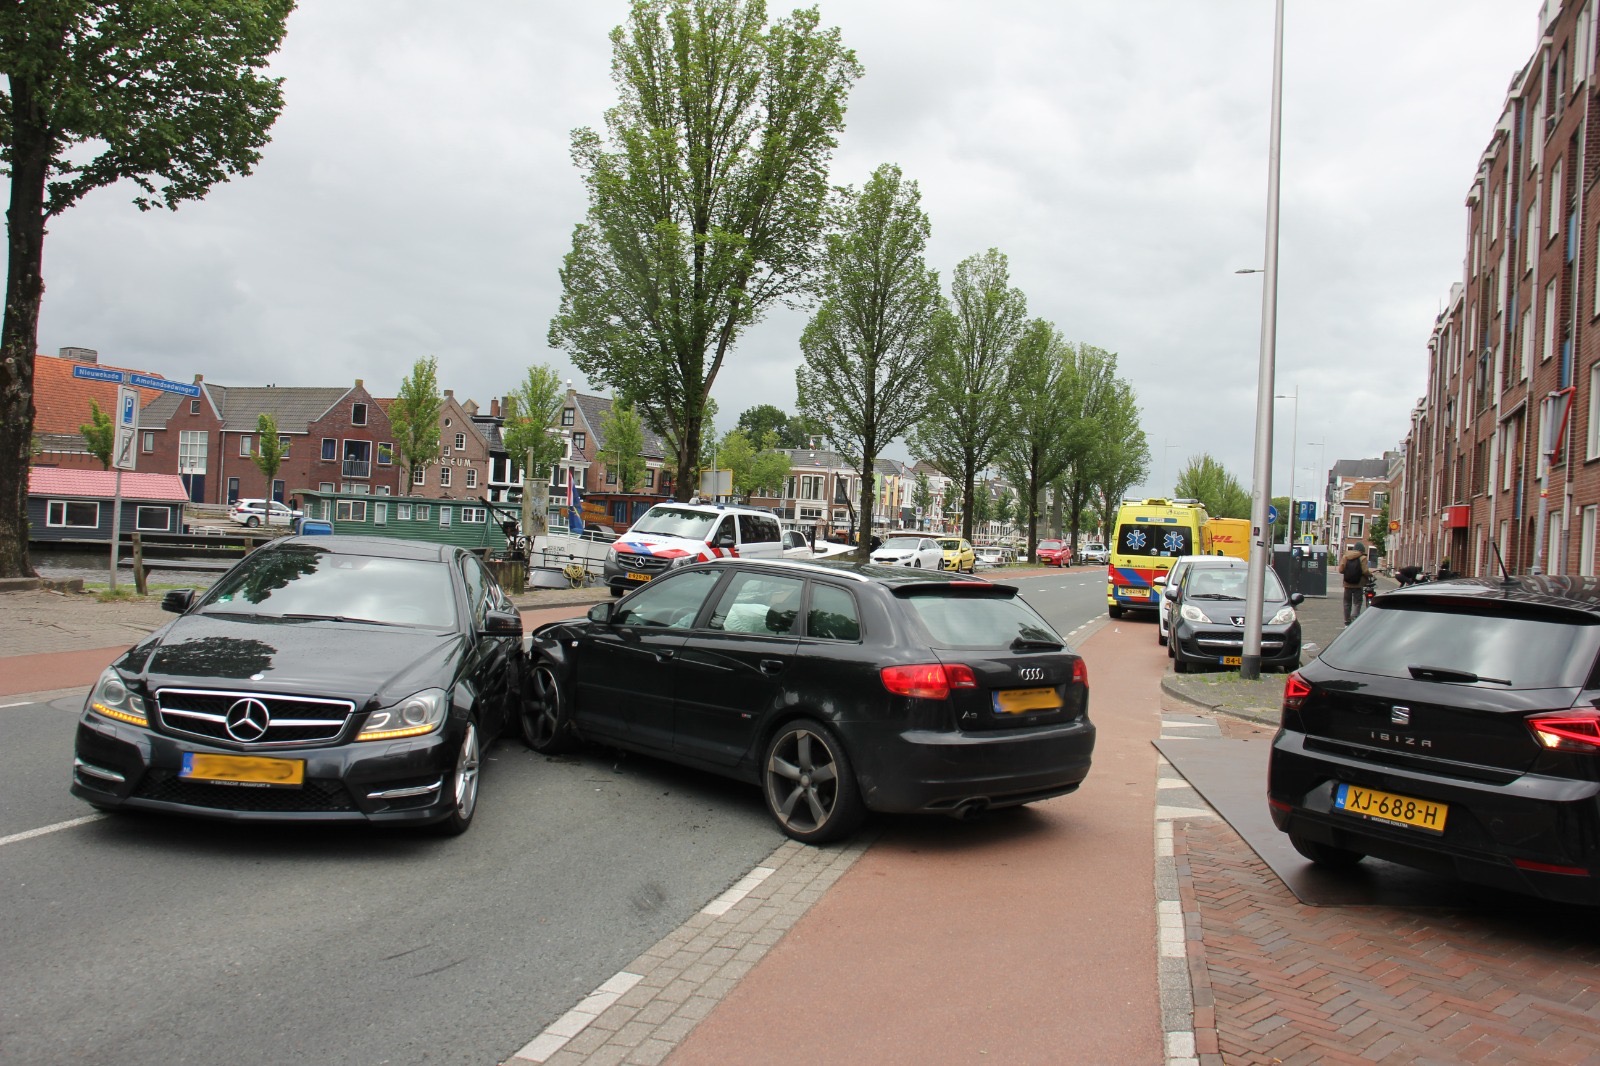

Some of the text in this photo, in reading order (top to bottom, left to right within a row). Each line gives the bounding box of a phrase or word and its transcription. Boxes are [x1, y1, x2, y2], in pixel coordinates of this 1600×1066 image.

[79, 368, 119, 380] Nieuwekade
[135, 376, 196, 394] Amelandsedwinger
[125, 398, 133, 413] P
[1301, 503, 1307, 514] P
[1292, 548, 1298, 556] P
[962, 711, 978, 719] A3
[1371, 731, 1432, 748] IBIZA
[1351, 789, 1438, 825] XJ-688-H
